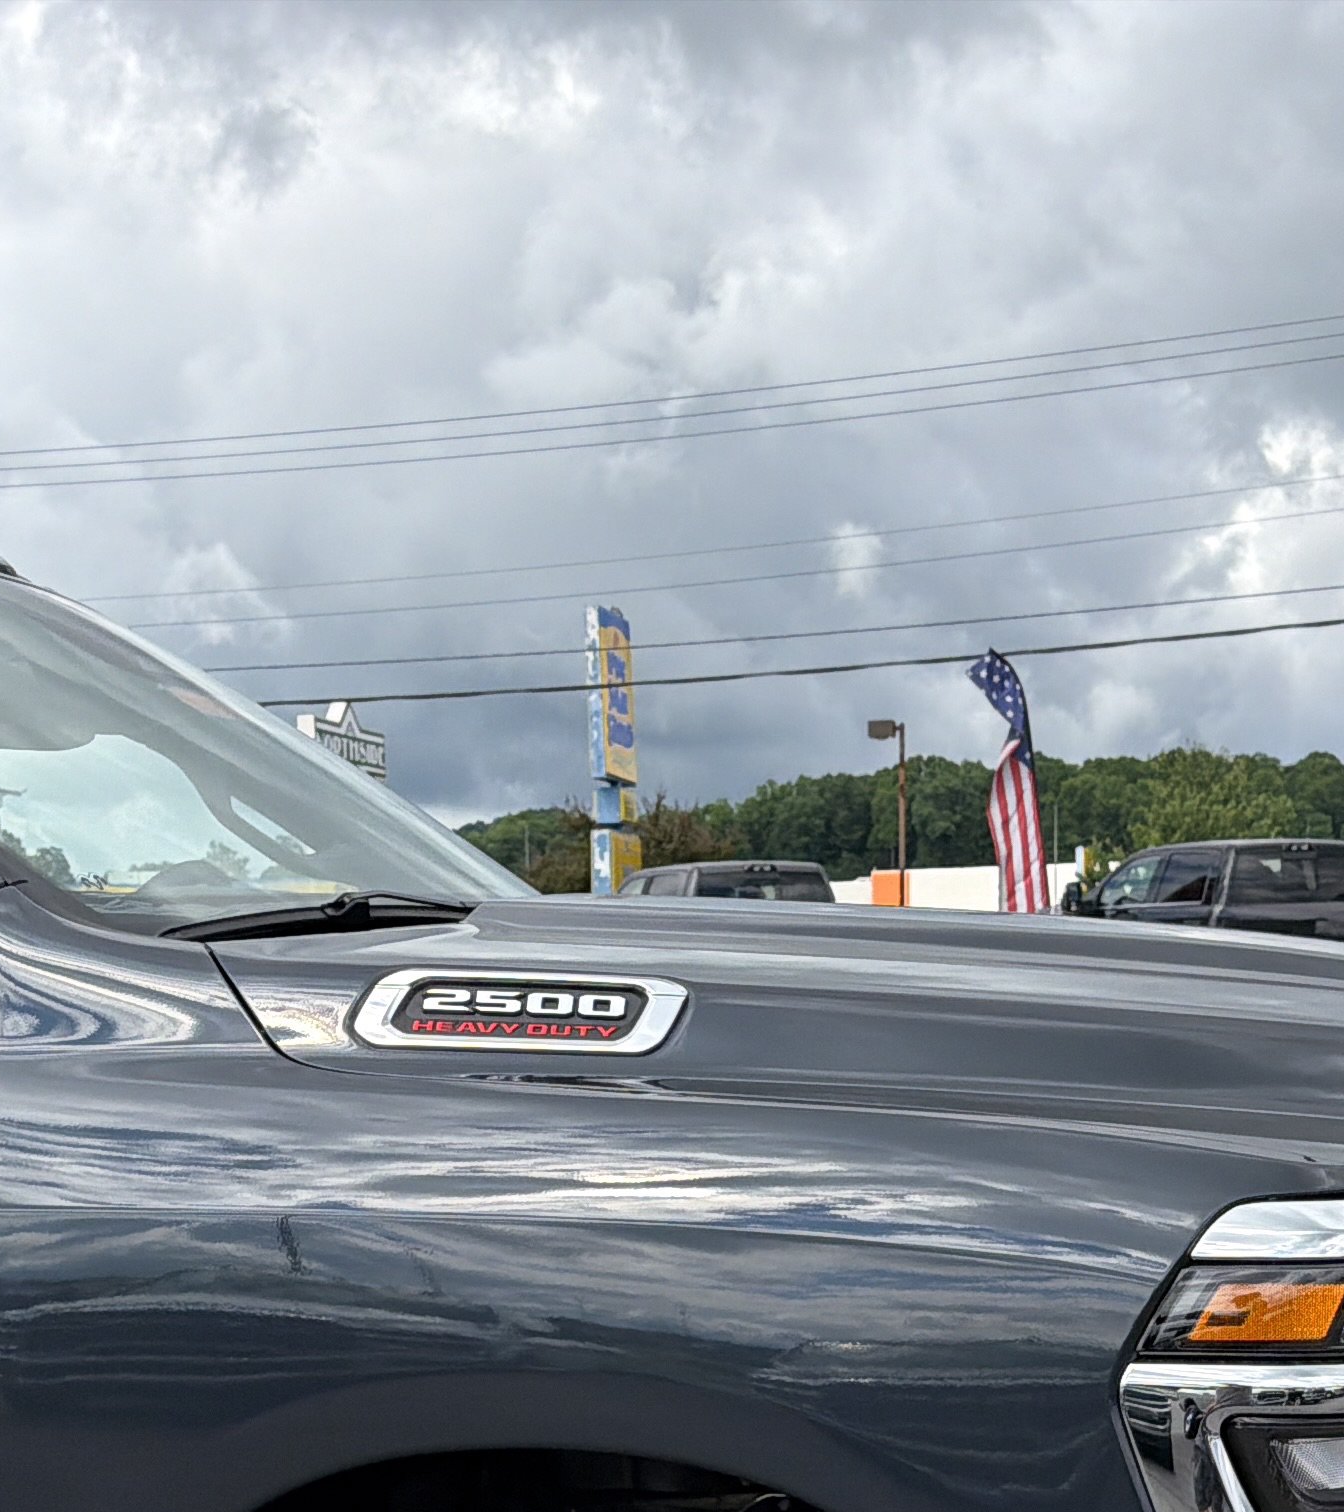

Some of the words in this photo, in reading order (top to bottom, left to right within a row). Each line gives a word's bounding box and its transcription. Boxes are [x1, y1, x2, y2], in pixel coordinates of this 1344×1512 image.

[421, 988, 627, 1018] 2500
[411, 1020, 520, 1035] HEAVY
[525, 1023, 618, 1039] DUTY
